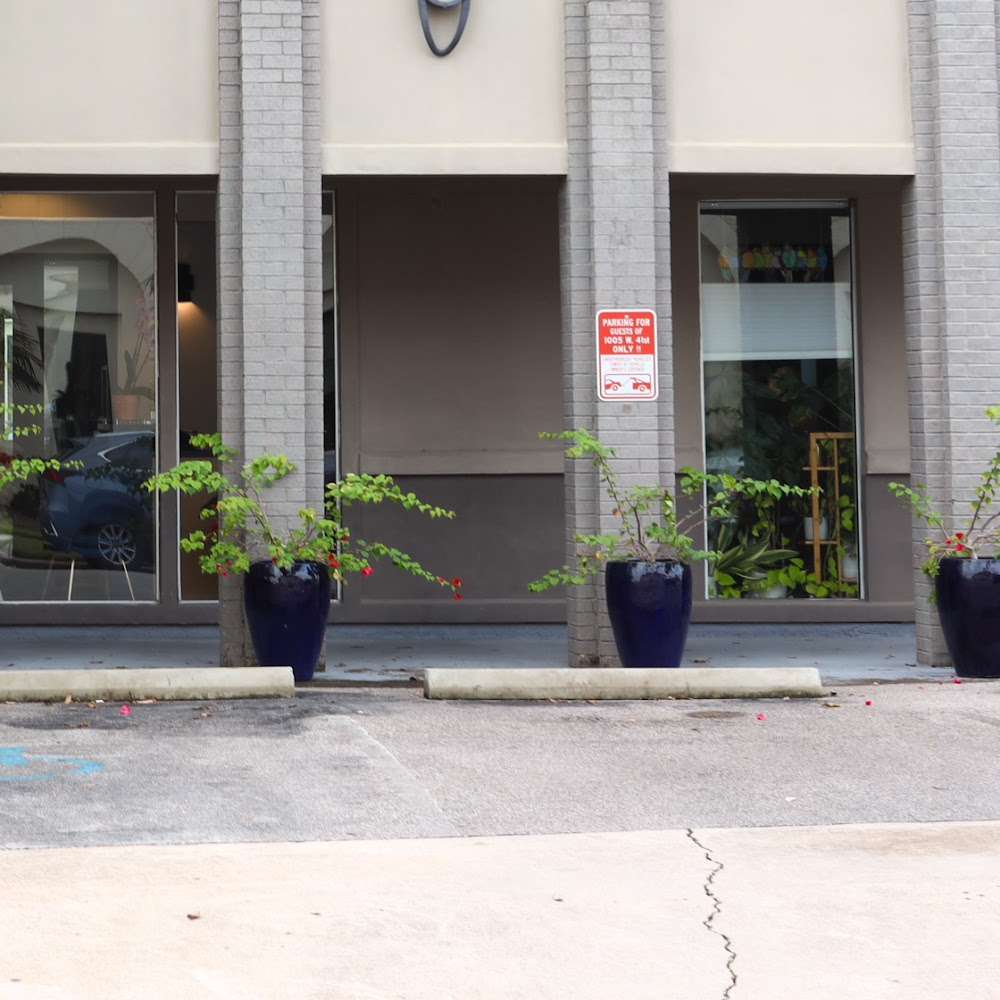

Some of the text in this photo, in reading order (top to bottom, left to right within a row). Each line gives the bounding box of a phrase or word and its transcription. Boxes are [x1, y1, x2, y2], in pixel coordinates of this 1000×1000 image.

[602, 318, 651, 326] PARKING FOR
[609, 327, 643, 335] GUESTS OF
[603, 336, 651, 344] 1005 W. 41st
[612, 345, 634, 353] ONLY
